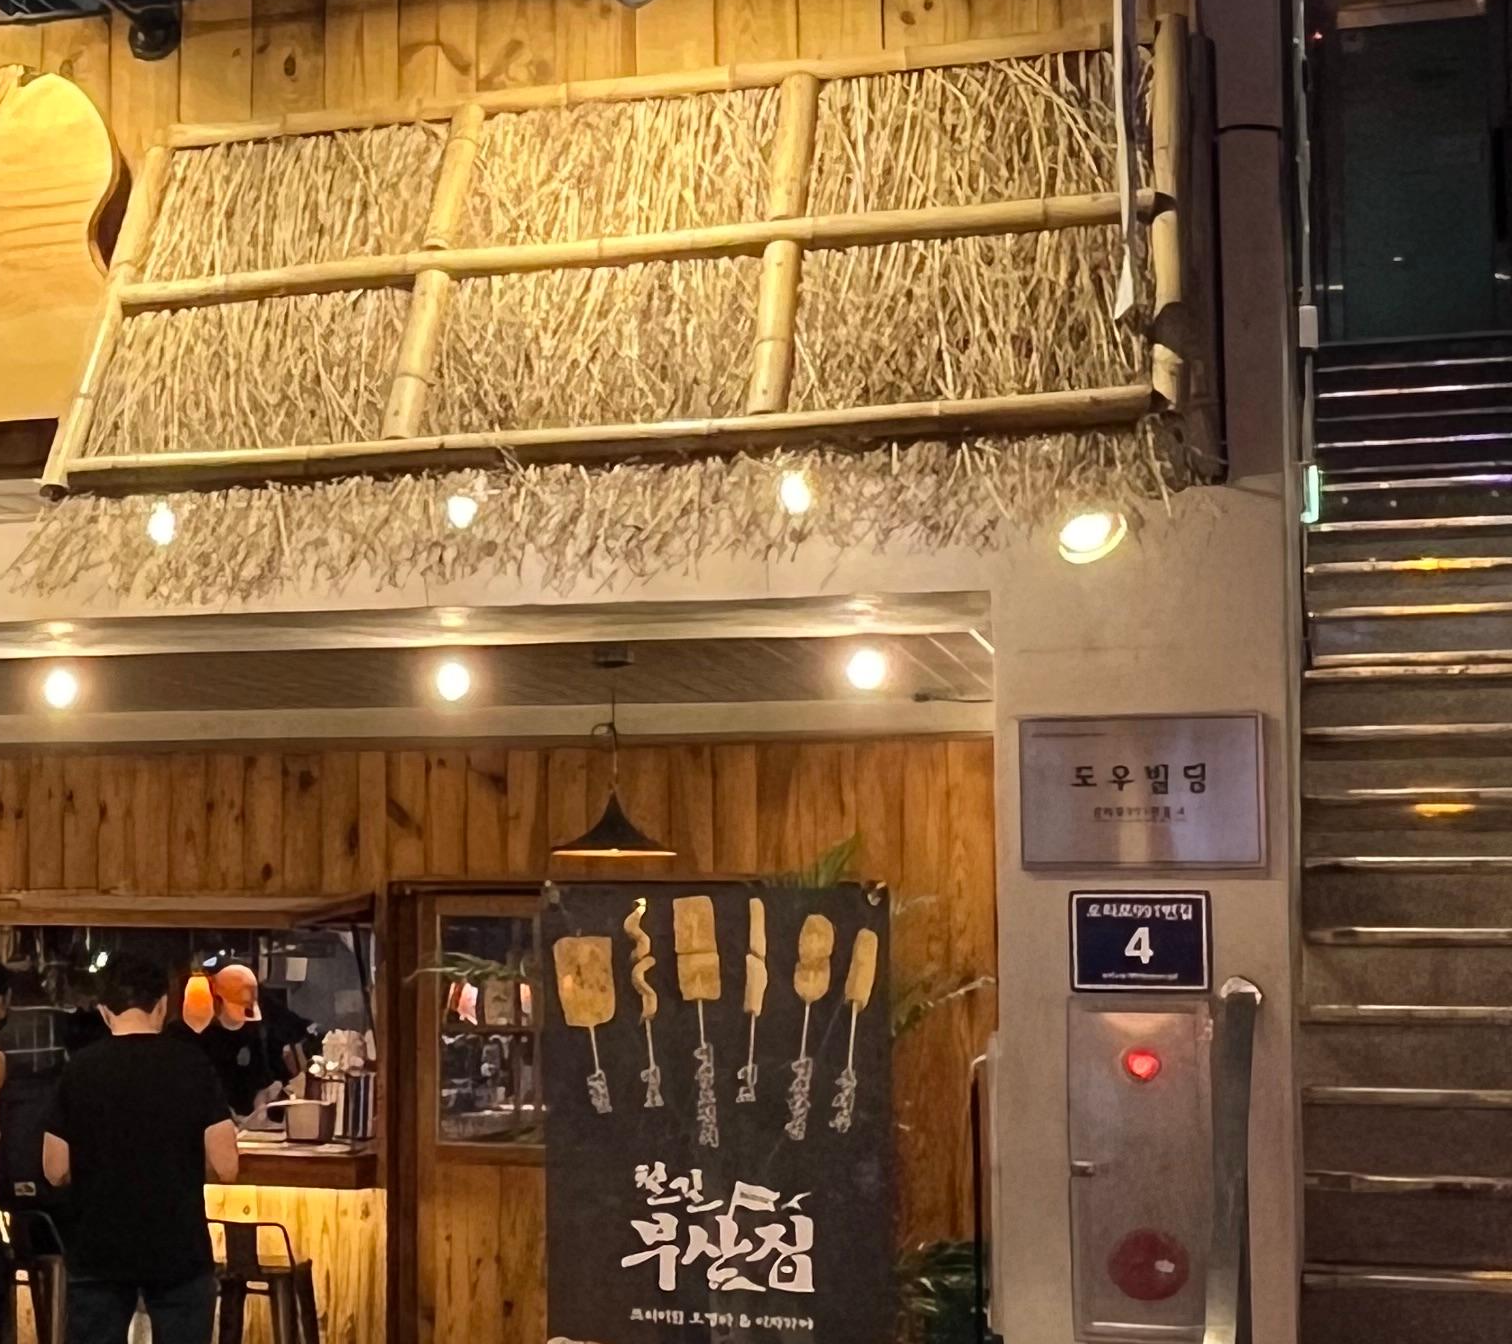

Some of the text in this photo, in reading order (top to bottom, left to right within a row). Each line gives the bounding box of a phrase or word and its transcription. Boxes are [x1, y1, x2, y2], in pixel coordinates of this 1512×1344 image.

[1070, 763, 1206, 794] 도우빌딩
[1124, 927, 1154, 964] 4
[621, 1212, 815, 1292] 부산집
